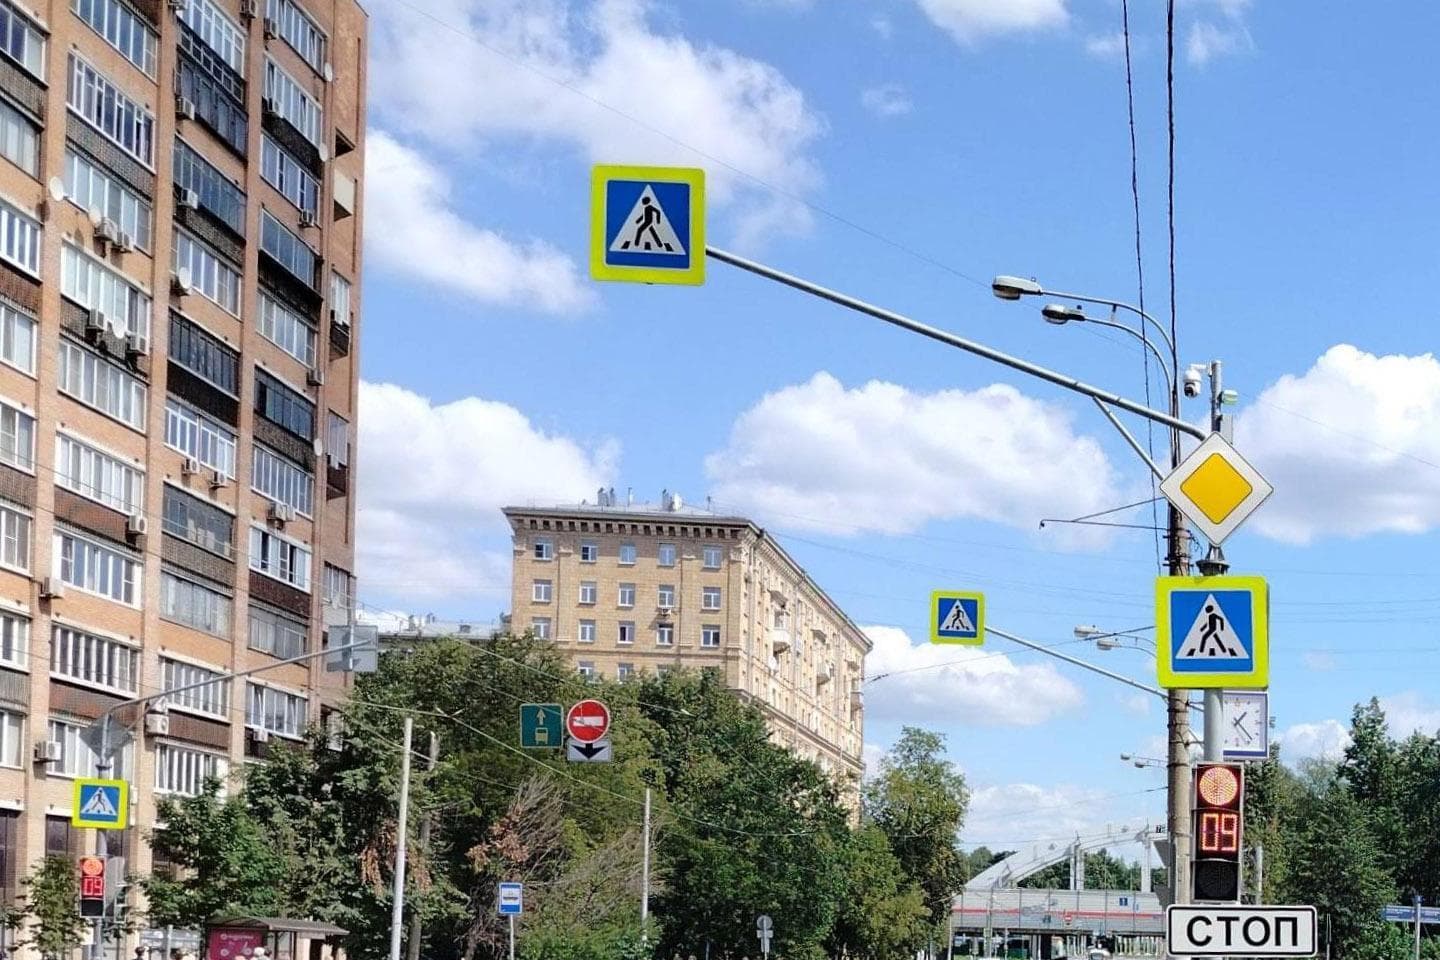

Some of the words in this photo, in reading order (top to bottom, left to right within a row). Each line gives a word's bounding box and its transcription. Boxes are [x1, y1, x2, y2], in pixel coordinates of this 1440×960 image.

[1202, 813, 1238, 851] 09
[84, 878, 103, 896] 09
[1186, 915, 1298, 947] СТОП
